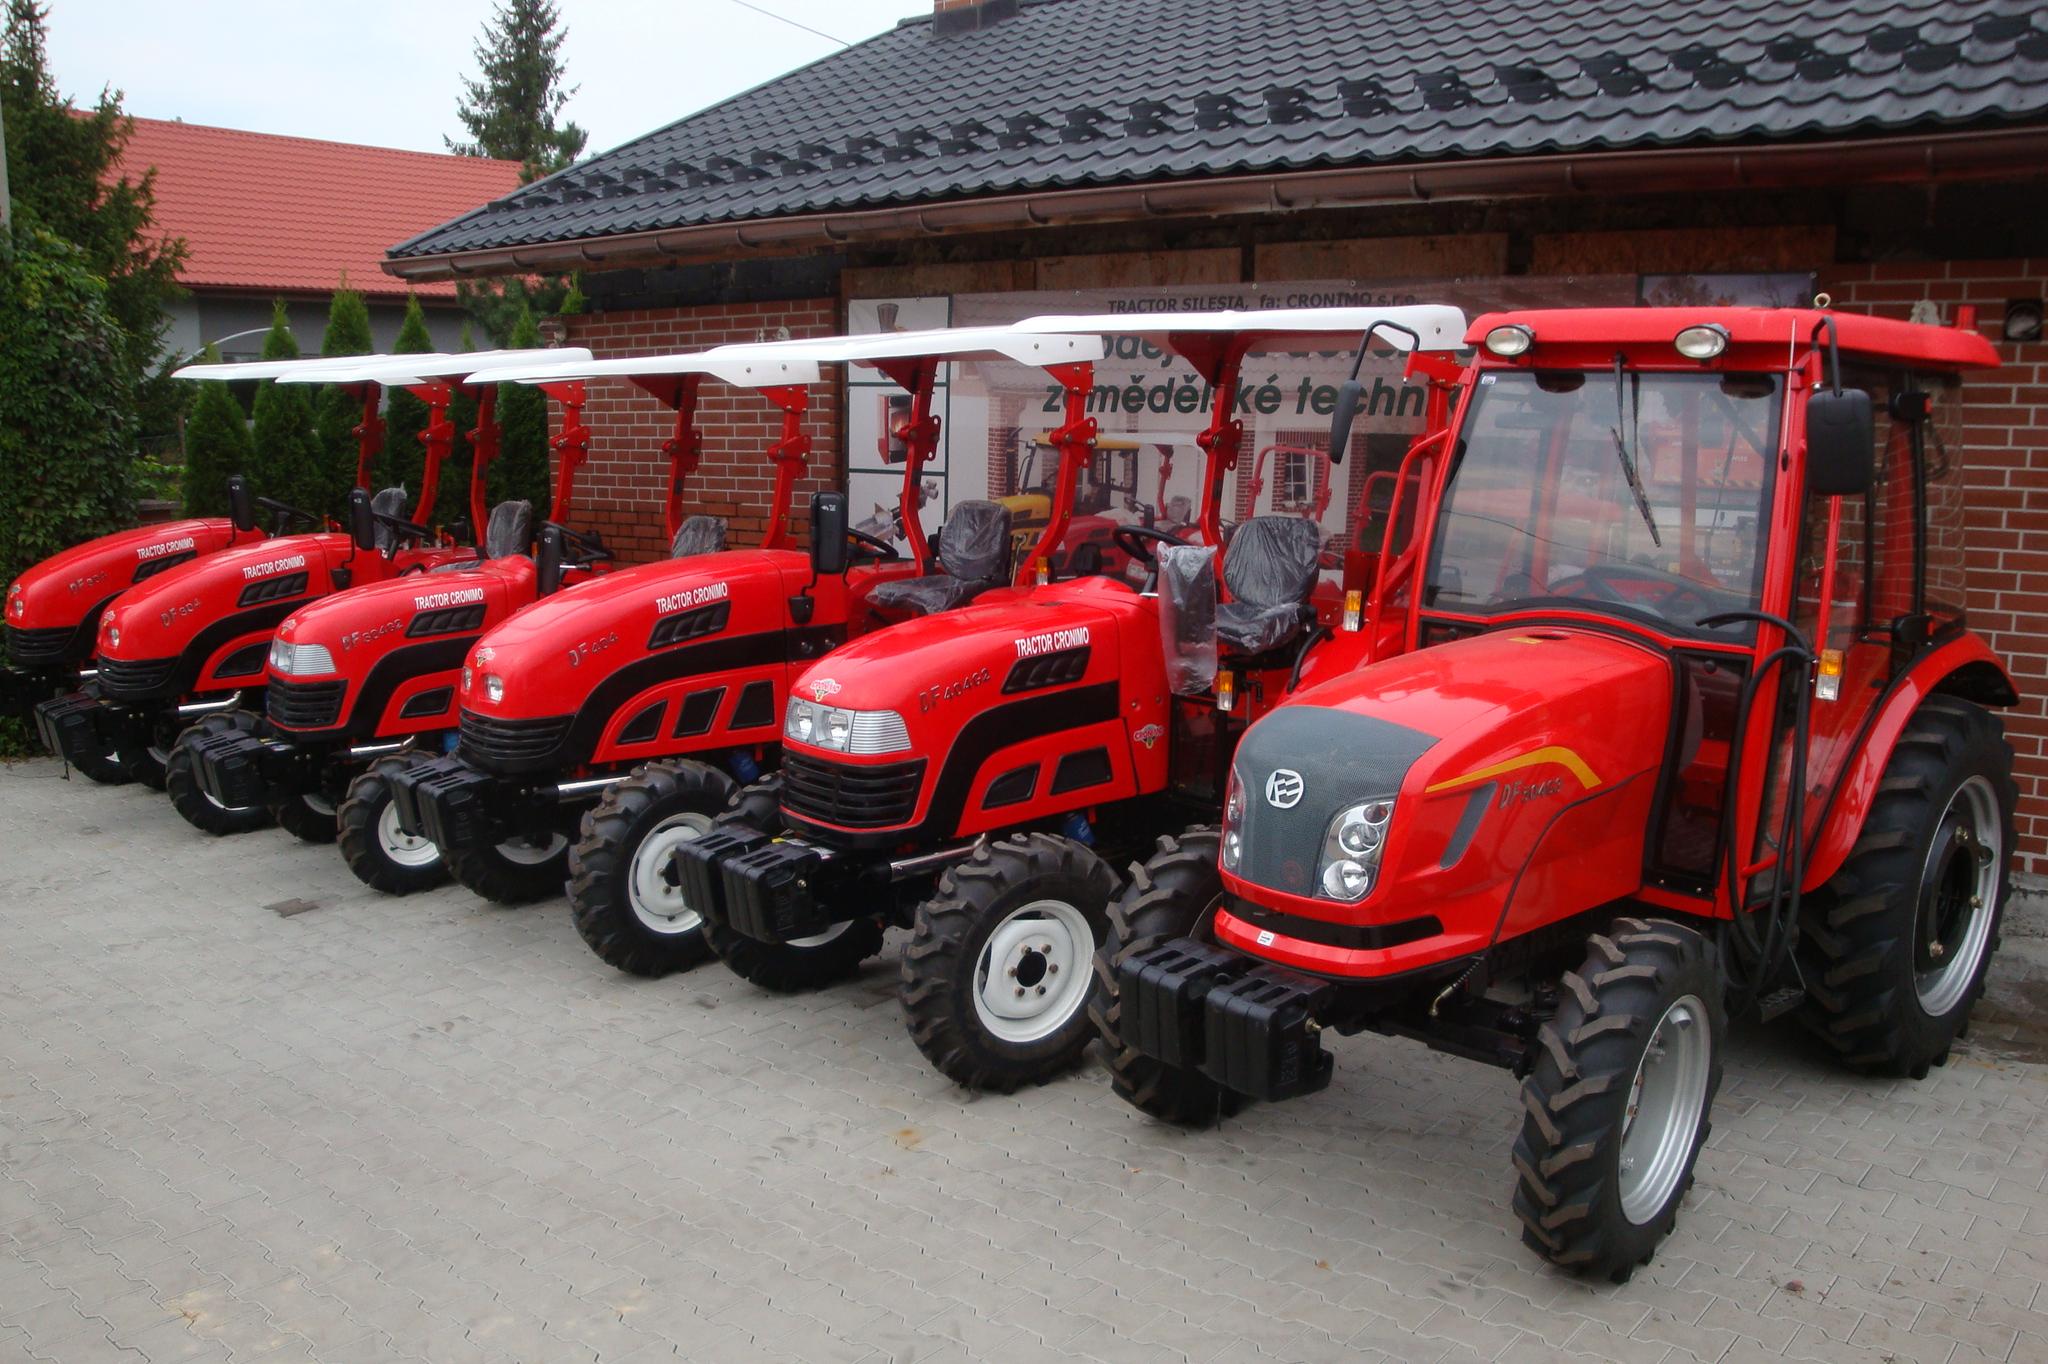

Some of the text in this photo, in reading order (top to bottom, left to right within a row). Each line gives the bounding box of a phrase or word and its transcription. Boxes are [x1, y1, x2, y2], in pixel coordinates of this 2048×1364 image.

[1108, 297, 1177, 313] TRACTOR
[1182, 295, 1249, 312] SILESIA,
[1286, 292, 1372, 308] CRONIMO
[1043, 374, 1281, 414] změdělké
[136, 538, 194, 559] TRACTOR CRONIMO
[242, 555, 305, 579] TRACTOR CRONIMO
[415, 588, 483, 610] TRACTOR CRONIMO
[656, 582, 728, 614] TRACTOR CRONIMO
[1014, 626, 1090, 657] TRACTOR CRONIMO
